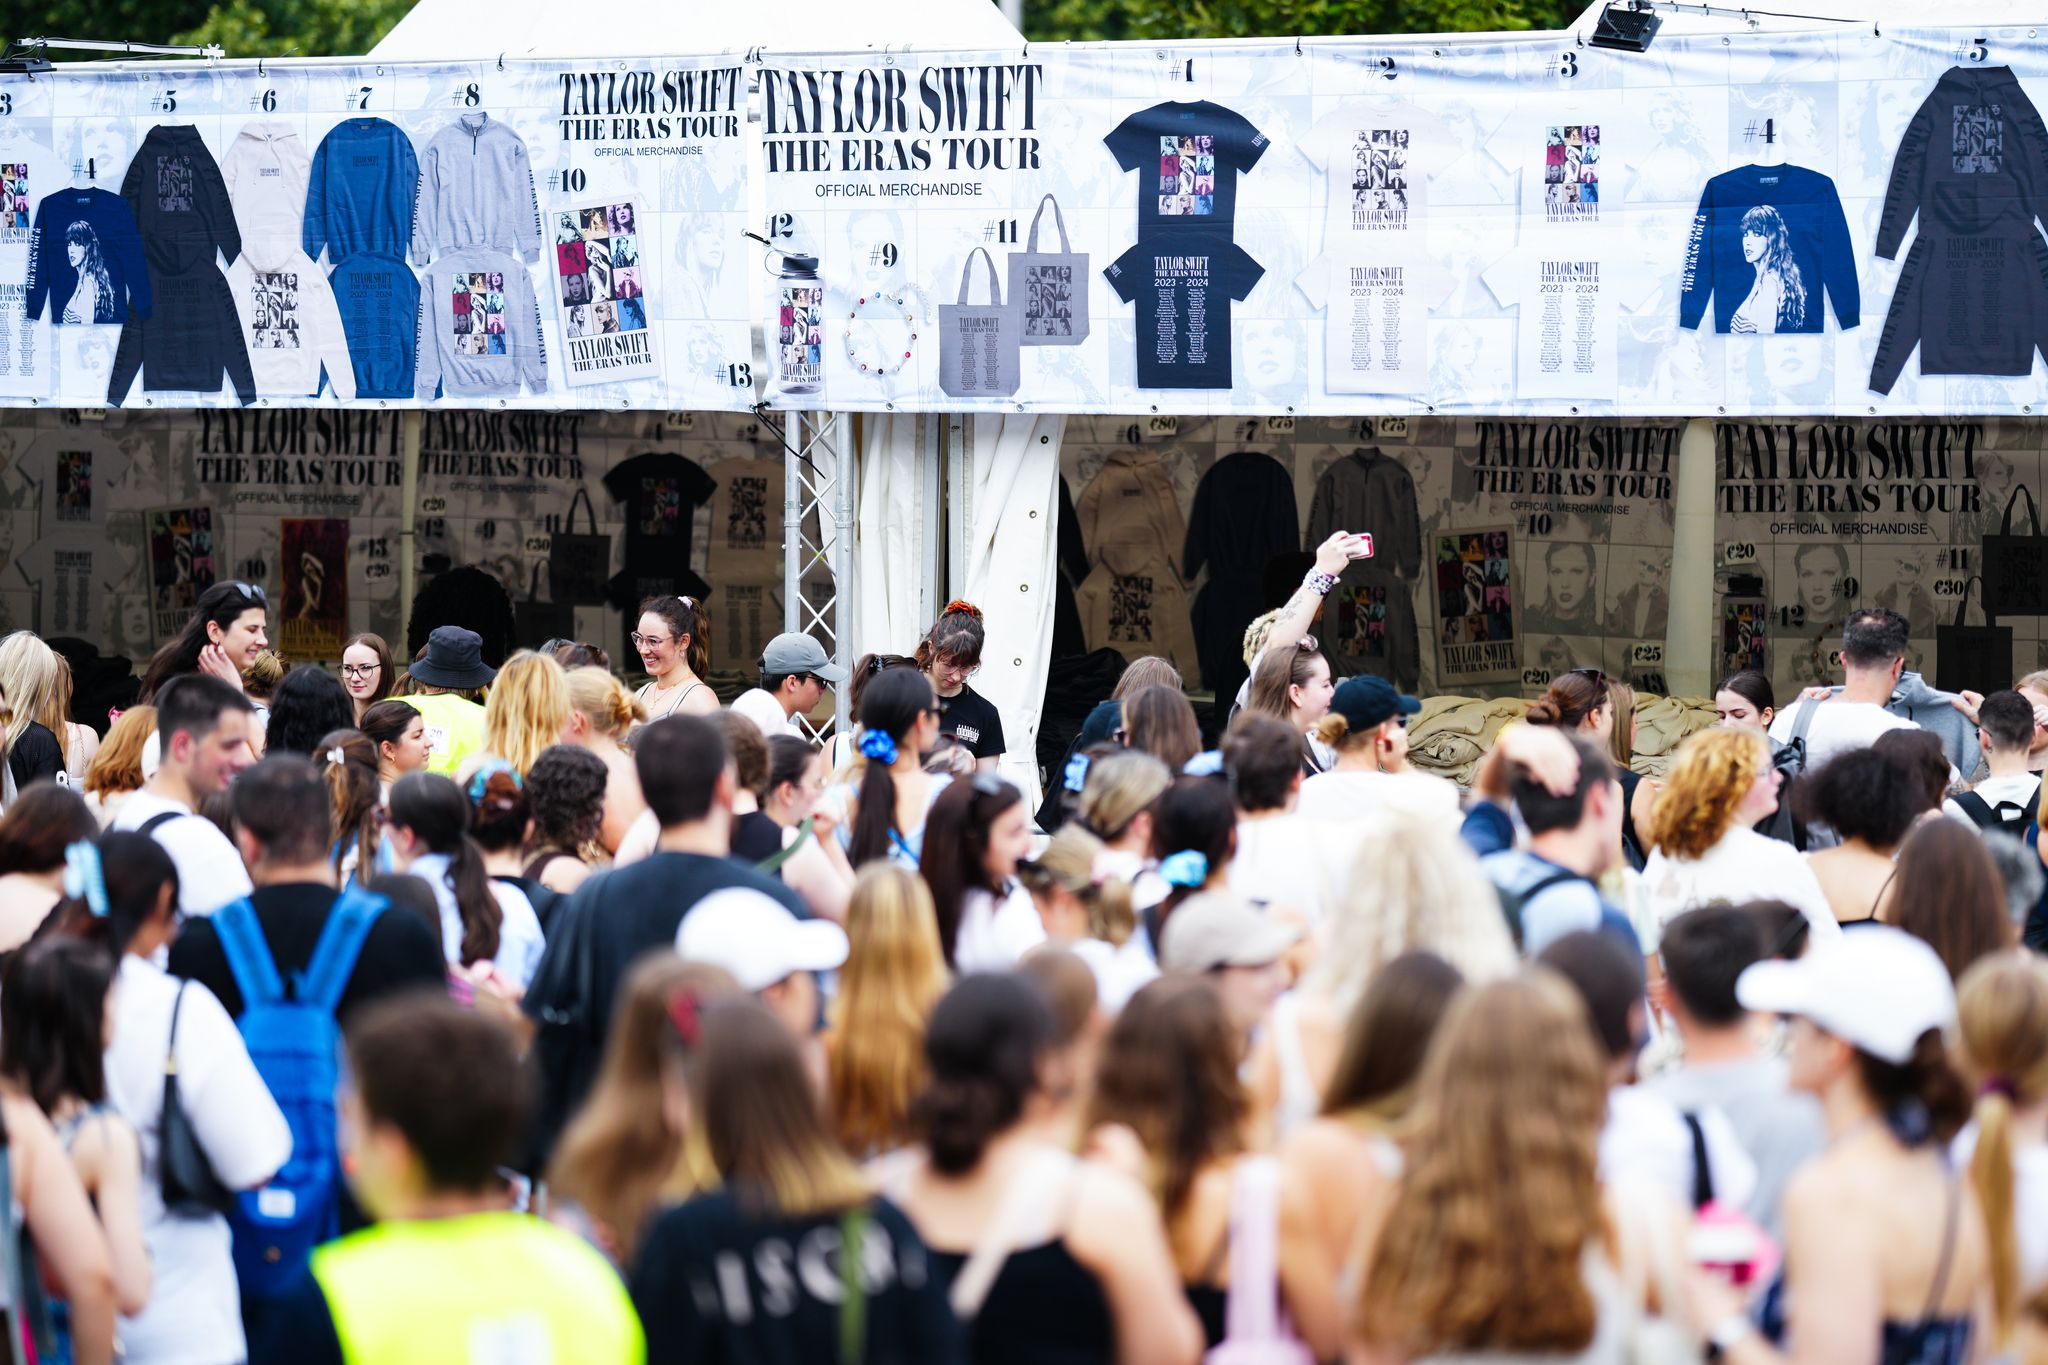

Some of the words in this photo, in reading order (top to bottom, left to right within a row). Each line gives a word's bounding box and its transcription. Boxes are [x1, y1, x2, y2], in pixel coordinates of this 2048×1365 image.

[1954, 38, 1988, 62] #5
[1169, 58, 1194, 82] #1
[1366, 56, 1398, 80] #2
[1546, 52, 1578, 78] #3
[150, 90, 177, 112] #5
[250, 88, 277, 112] #6
[347, 86, 373, 110] #7
[452, 83, 480, 107] #8
[559, 71, 658, 116] TAYLOR
[661, 67, 742, 115] SWIFT
[757, 68, 909, 134] TAYLOR
[919, 65, 1043, 133] SWIFT
[559, 118, 605, 141] THE
[612, 117, 671, 140] ERAS
[677, 115, 739, 139] TOUR
[1744, 119, 1776, 144] #4
[594, 147, 634, 158] OFFICIAL
[637, 145, 703, 156] MERCHANDISE
[763, 139, 831, 172] THE
[841, 138, 932, 171] ERAS
[942, 138, 1042, 170] TOUR
[72, 157, 97, 180] #4
[548, 168, 586, 192] #10
[816, 184, 876, 198] OFFICIAL
[879, 182, 983, 196] MERCHANDISE
[1352, 210, 1382, 224] TAYLOR
[1384, 210, 1408, 224] SWIFT
[1546, 203, 1574, 216] TAYLOR
[1576, 203, 1600, 216] SWIFT
[983, 219, 1018, 244] #11
[869, 242, 898, 268] #9
[1154, 256, 1184, 270] TAYLOR
[1185, 256, 1209, 270] SWIFT
[1350, 267, 1378, 280] TAYLOR
[1381, 267, 1404, 280] SWIFT
[1540, 262, 1572, 275] TAYLOR
[1574, 262, 1600, 275] SWIFT
[1154, 278, 1176, 286] 2023
[1186, 278, 1208, 286] 2024
[1382, 288, 1404, 296] 2024
[1540, 284, 1564, 292] 2023
[1576, 284, 1598, 292] 2024
[960, 318, 980, 328] TAYLOR
[982, 318, 1000, 328] SWIFT
[568, 337, 613, 362] TAYLOR
[614, 332, 649, 358] SWIFT
[572, 361, 594, 372] THE
[596, 357, 622, 370] ERAS
[624, 353, 652, 366] TOUR
[714, 362, 752, 388] #13
[196, 408, 306, 454] TAYLOR
[315, 408, 400, 456] SWIFT
[423, 411, 504, 452] TAYLOR
[510, 414, 585, 454] SWIFT
[1116, 424, 1140, 444] #6
[1150, 417, 1176, 431] €80
[1235, 420, 1258, 441] #7
[1268, 417, 1293, 430] €75
[1350, 418, 1374, 440] #8
[1380, 418, 1406, 432] €75
[1476, 422, 1581, 470] TAYLOR
[1587, 426, 1679, 473] SWIFT
[1716, 424, 1858, 480] TAYLOR
[1867, 424, 1984, 480] SWIFT
[197, 458, 249, 483] THE
[257, 459, 324, 484] ERAS
[332, 460, 400, 486] TOUR
[420, 452, 462, 474] THE
[468, 455, 518, 476] ERAS
[524, 457, 582, 480] TOUR
[1474, 470, 1524, 494] THE
[1530, 472, 1596, 496] ERAS
[1603, 474, 1672, 500] TOUR
[236, 492, 280, 504] OFFICIAL
[284, 494, 360, 506] MERCHANDISE
[423, 498, 445, 511] €20
[1510, 501, 1554, 514] OFFICIAL
[1556, 502, 1630, 516] MERCHANDISE
[1720, 484, 1786, 513] THE
[1796, 484, 1880, 513] ERAS
[1890, 484, 1982, 513] TOUR
[1516, 514, 1551, 536] #10
[1770, 522, 1828, 536] OFFICIAL
[1832, 522, 1928, 535] MERCHANDISE
[1726, 543, 1755, 560] €20
[1936, 548, 1968, 570] #11
[1831, 576, 1858, 599] #9
[1934, 580, 1964, 596] €30
[1769, 604, 1804, 626] #12
[1442, 646, 1484, 664] TAYLOR
[1484, 643, 1514, 662] SWIFT
[1634, 646, 1662, 662] €25
[1445, 664, 1466, 674] THE
[1467, 663, 1489, 673] ERAS
[1492, 661, 1517, 671] TOUR
[1523, 670, 1550, 685] €20
